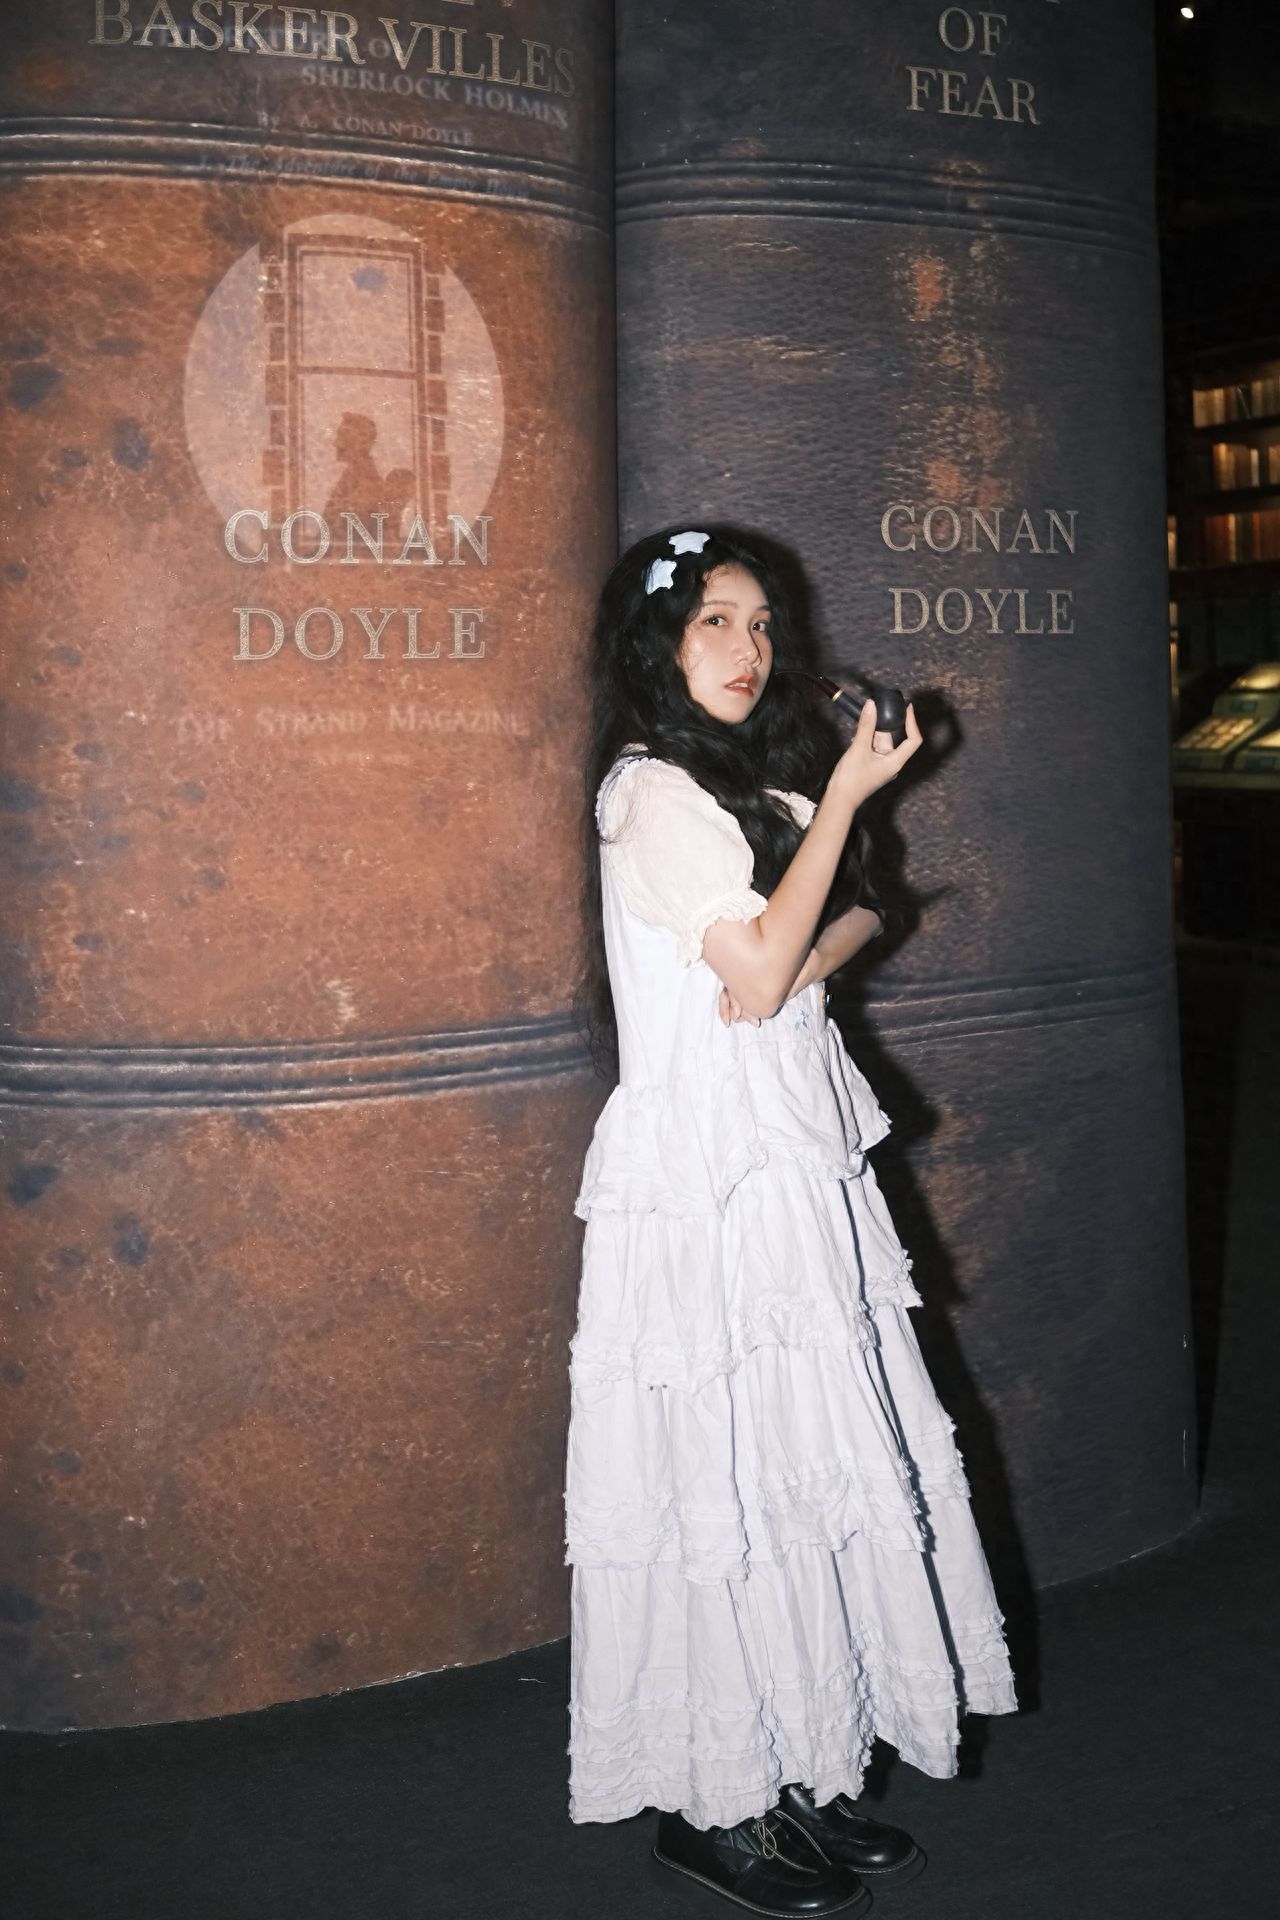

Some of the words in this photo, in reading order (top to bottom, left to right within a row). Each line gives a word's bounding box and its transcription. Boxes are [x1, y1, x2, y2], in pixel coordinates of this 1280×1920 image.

[938, 7, 1008, 56] OF
[302, 65, 450, 102] SHERLOCK
[464, 84, 568, 130] HOLMES
[905, 65, 1041, 125] FEAR
[333, 116, 402, 135] CONAN
[411, 124, 474, 146] DOYLE
[224, 509, 494, 566] CONAN
[880, 505, 1079, 554] CONAN
[232, 607, 487, 661] DOYLE
[888, 587, 1075, 634] DOYLE
